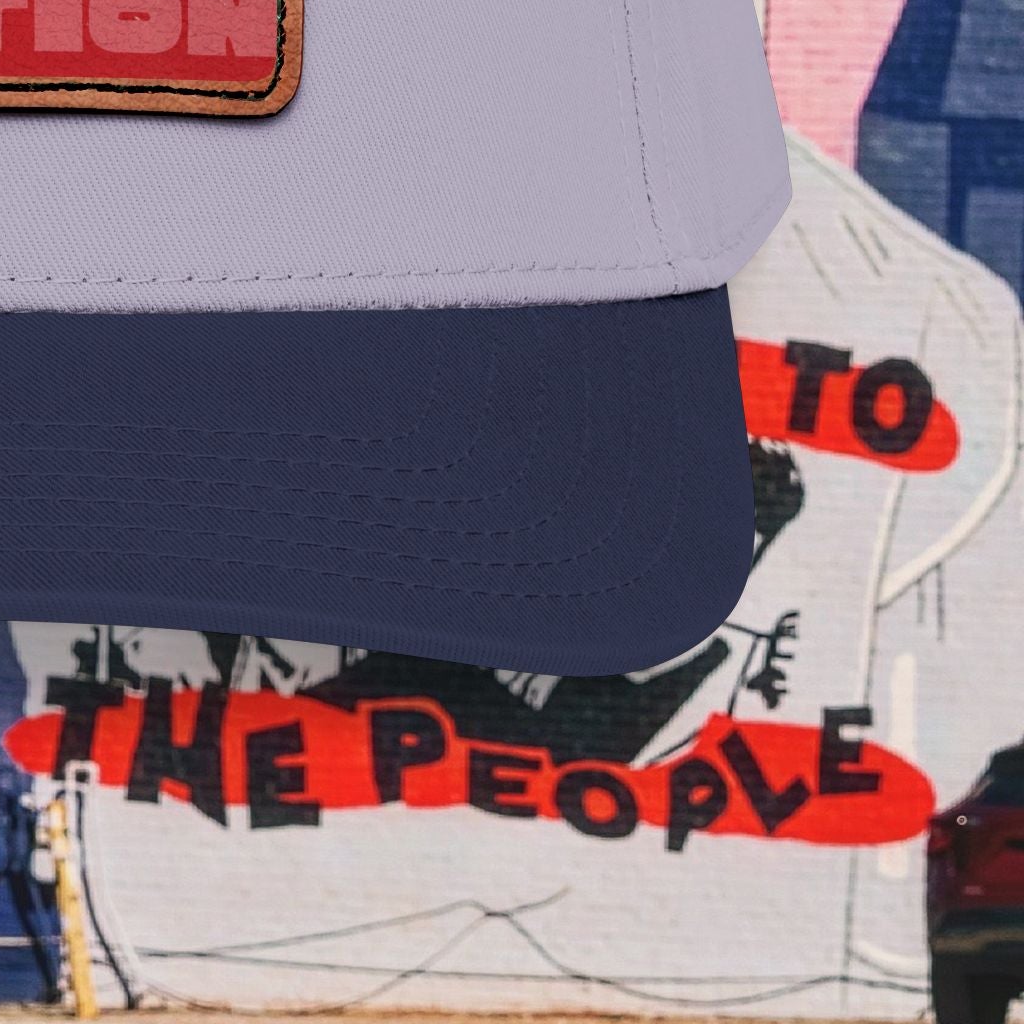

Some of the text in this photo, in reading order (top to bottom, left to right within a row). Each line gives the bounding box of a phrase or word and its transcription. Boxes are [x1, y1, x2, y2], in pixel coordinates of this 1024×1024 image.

[785, 339, 933, 455] TO
[46, 675, 882, 852] THE PEOPLE
